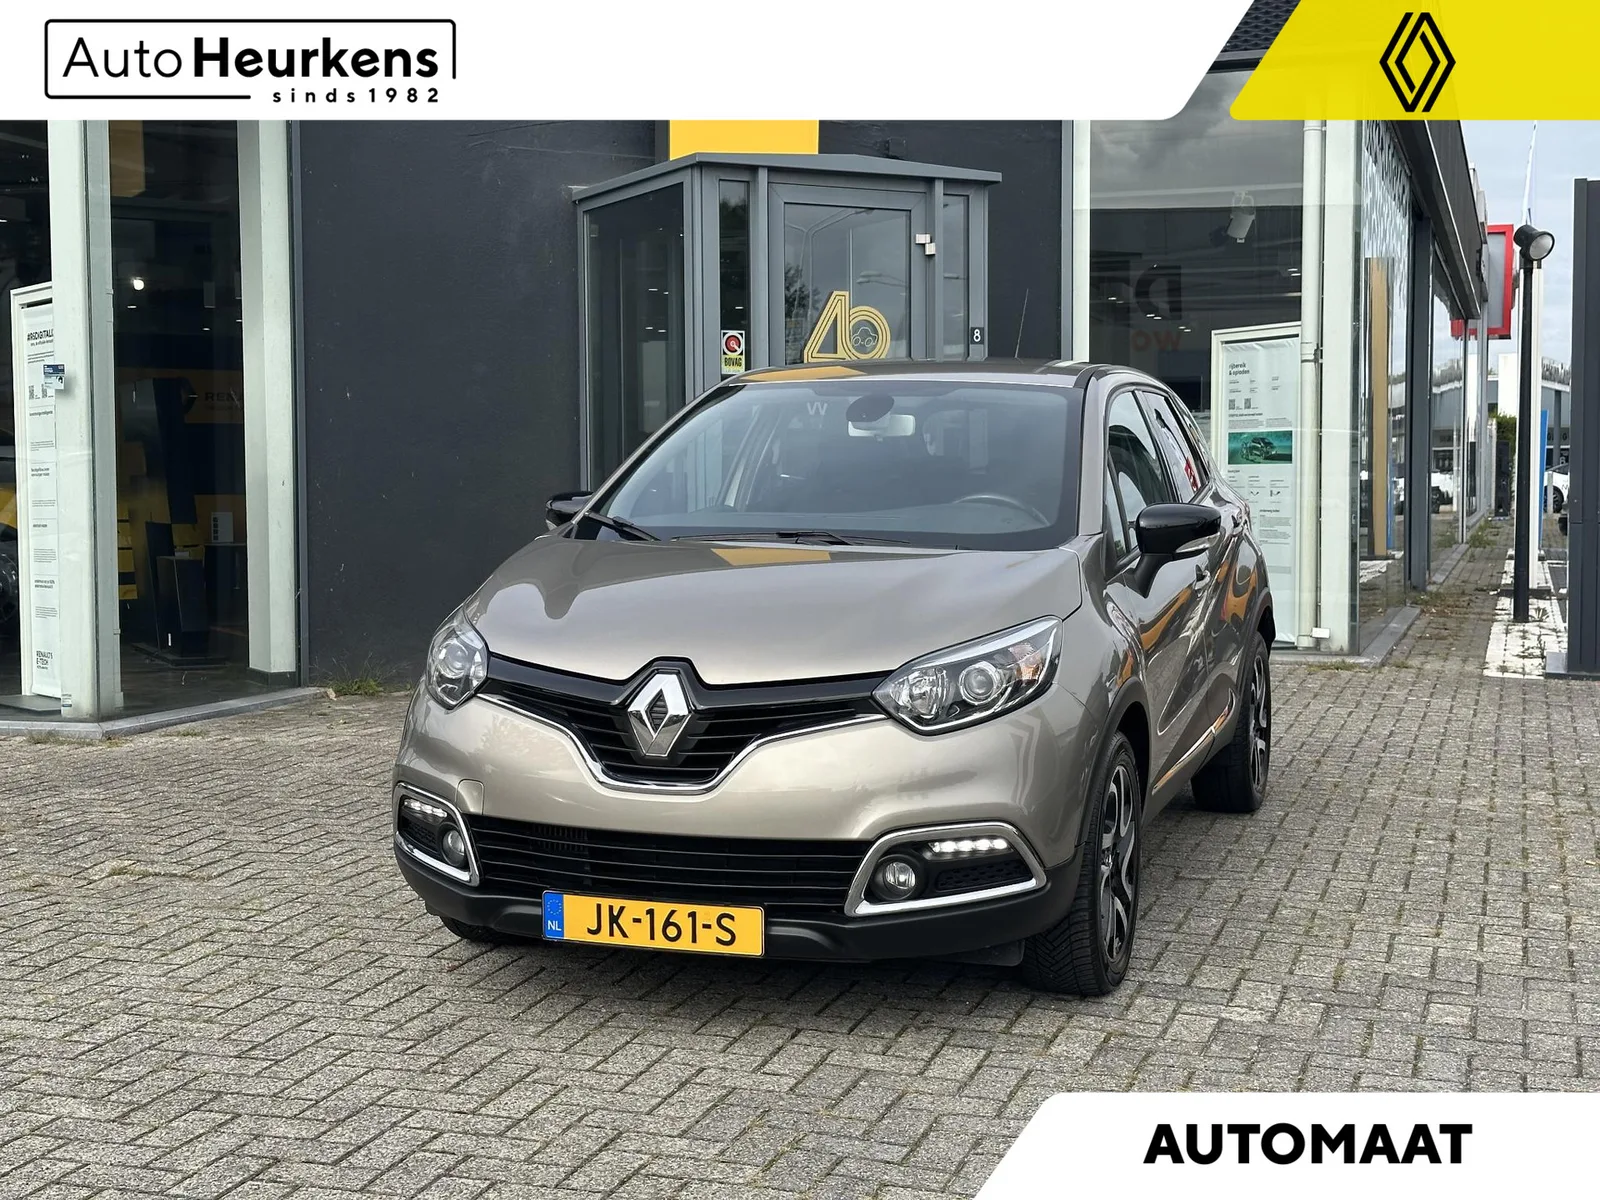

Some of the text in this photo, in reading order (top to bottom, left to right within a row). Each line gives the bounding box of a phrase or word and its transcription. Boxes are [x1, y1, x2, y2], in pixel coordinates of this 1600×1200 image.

[973, 329, 981, 342] 8
[724, 357, 743, 368] BOVAG
[547, 920, 562, 932] NL
[586, 903, 736, 947] JK-161-S
